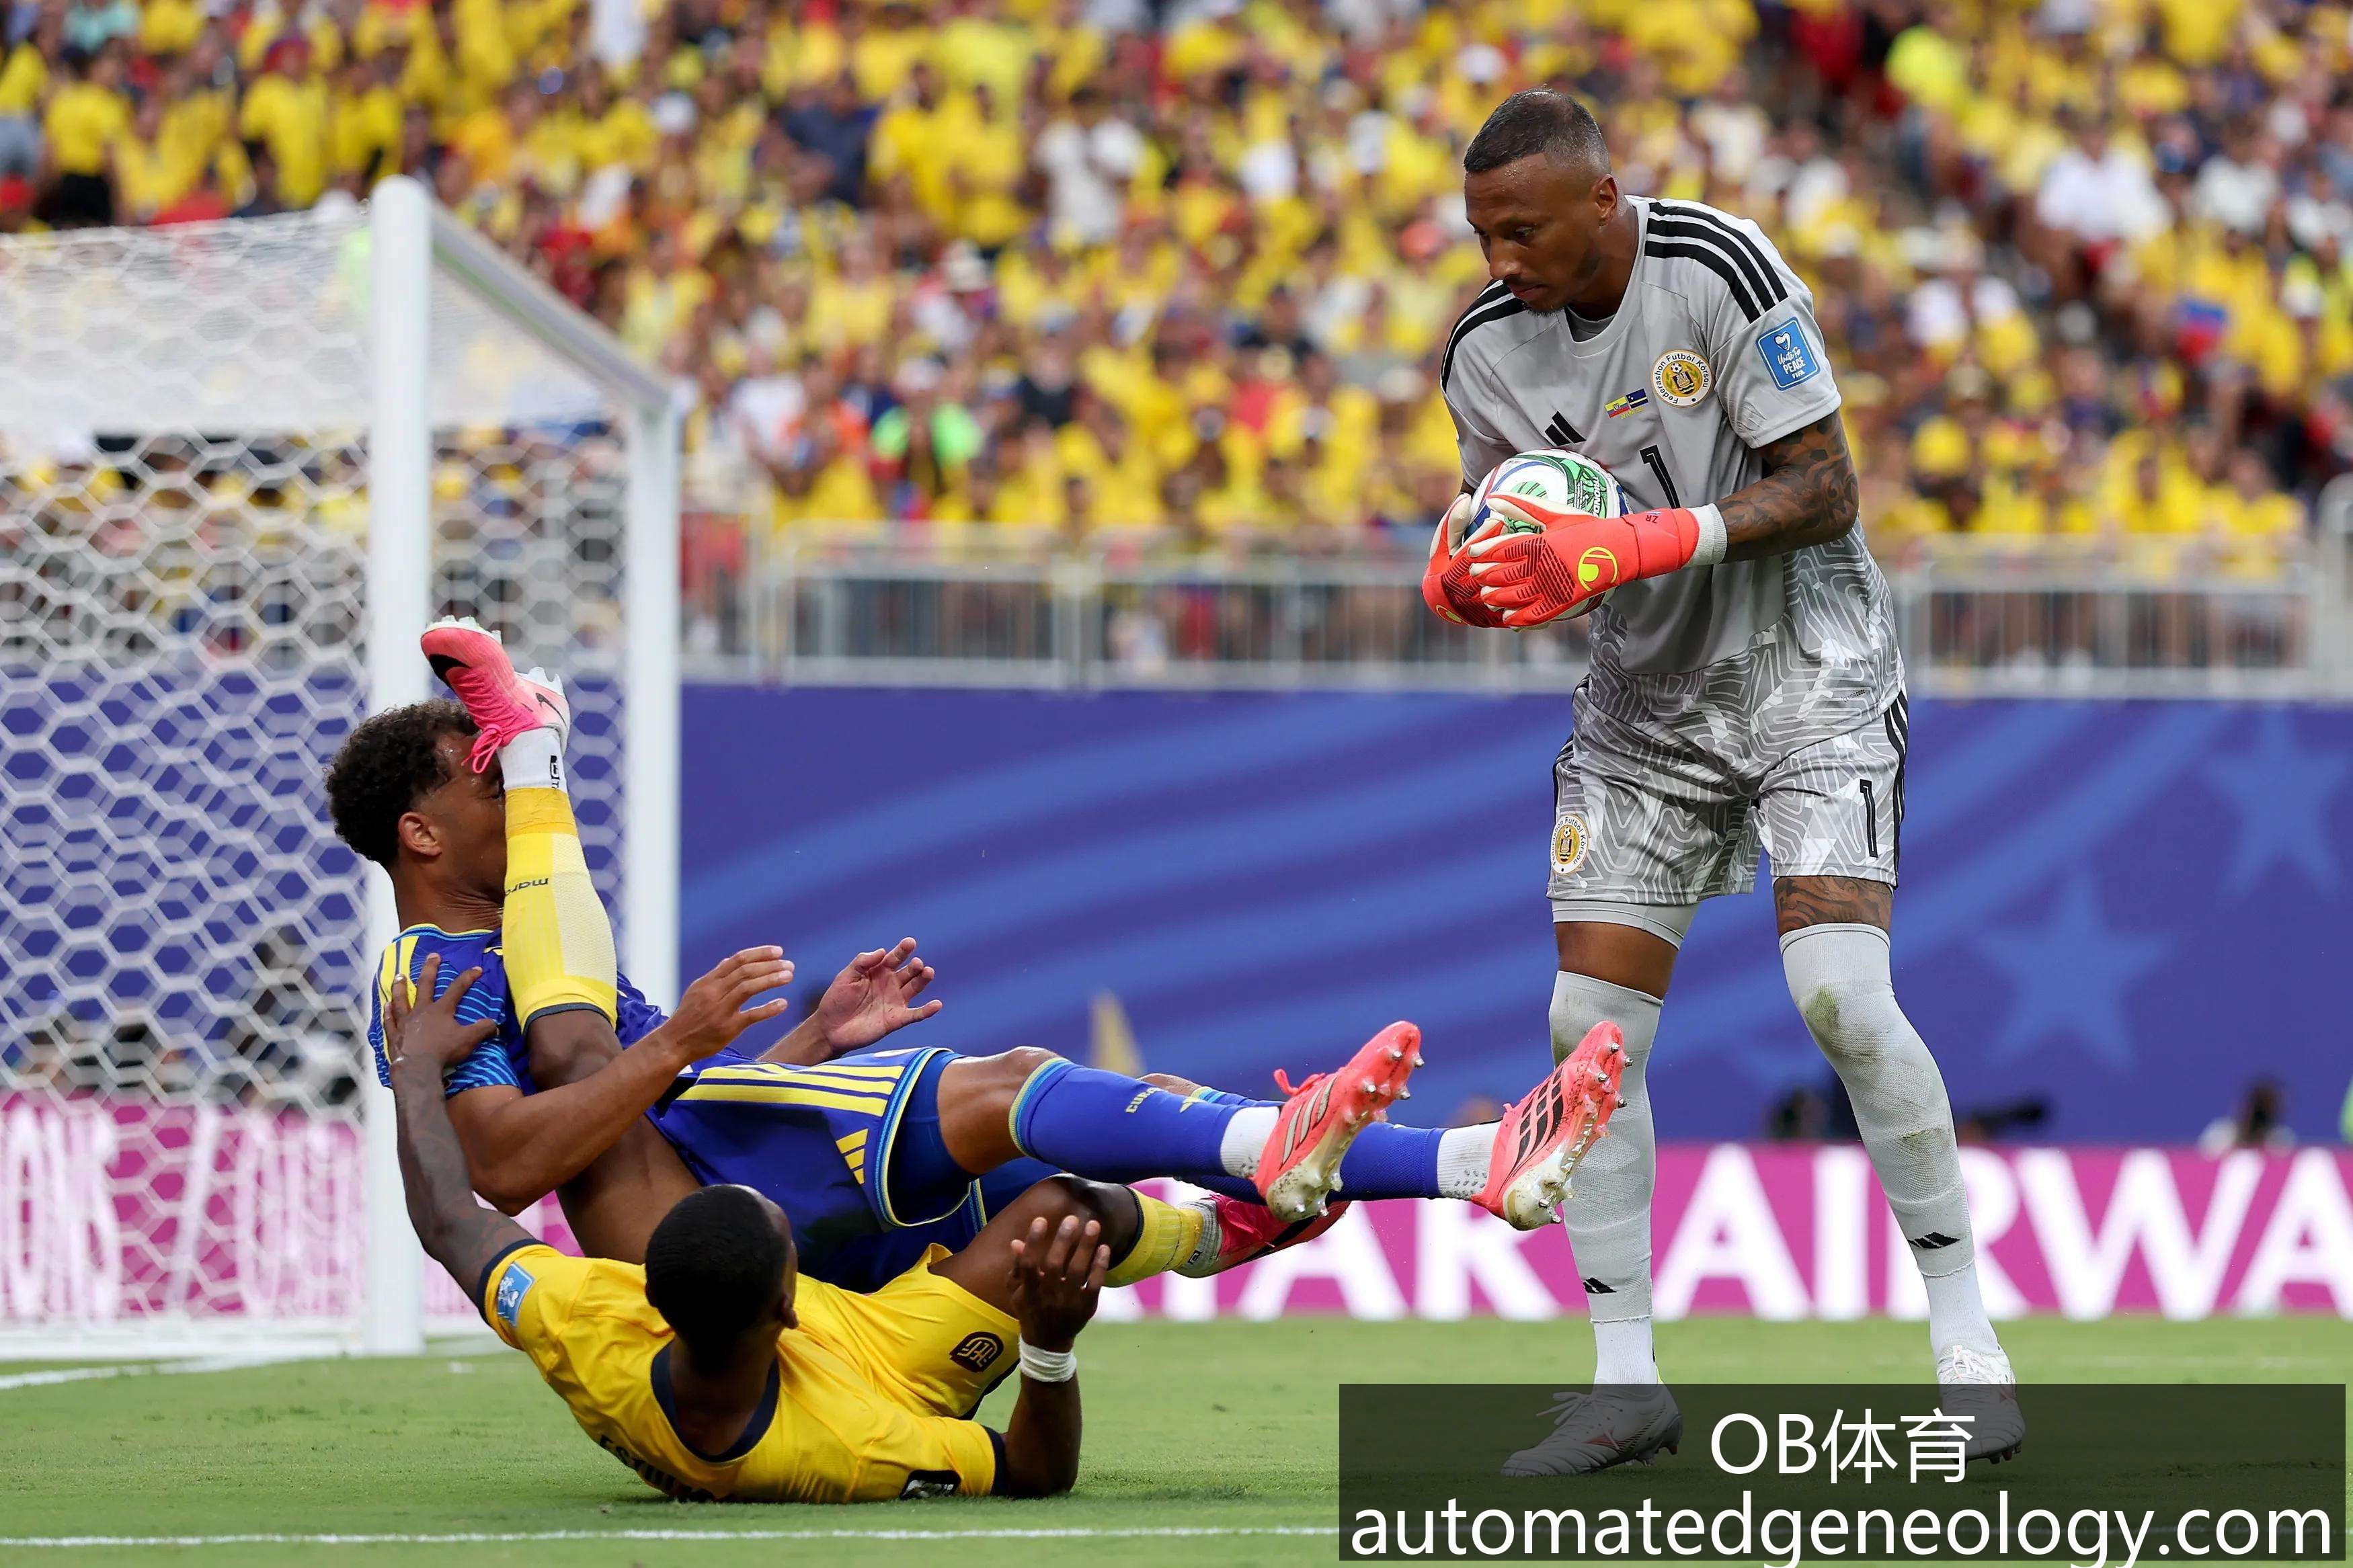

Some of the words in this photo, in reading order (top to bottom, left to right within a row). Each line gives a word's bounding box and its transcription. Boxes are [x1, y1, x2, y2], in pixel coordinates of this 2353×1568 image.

[1782, 356, 1806, 374] PEACE
[1791, 370, 1806, 379] FIFA
[1639, 444, 1681, 509] 1
[1860, 778, 1879, 859] 1
